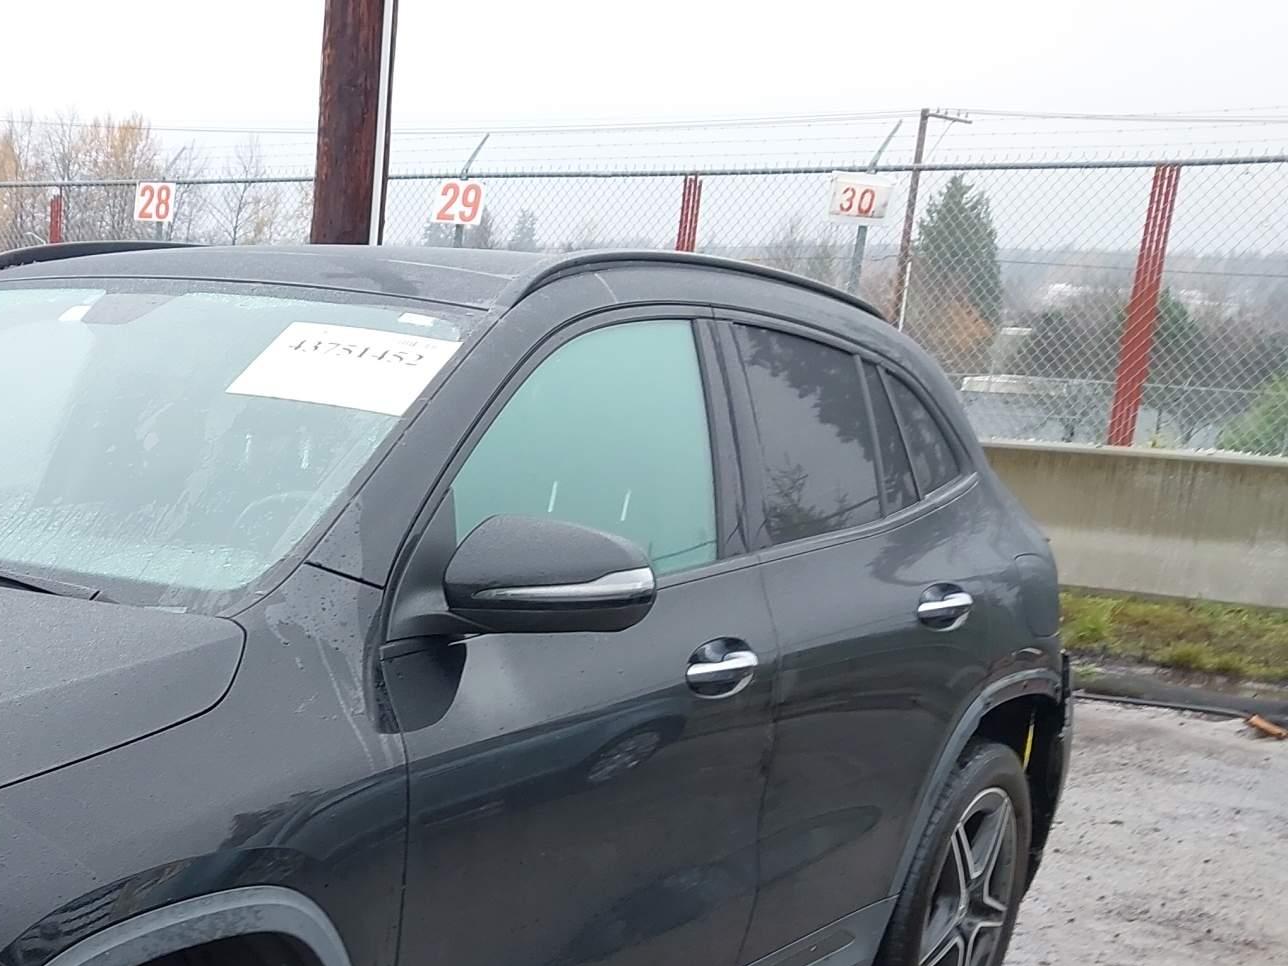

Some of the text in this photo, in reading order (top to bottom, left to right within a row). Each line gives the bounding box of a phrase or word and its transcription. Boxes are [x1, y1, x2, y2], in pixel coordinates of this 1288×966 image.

[139, 184, 171, 219] 28
[436, 182, 482, 222] 29
[839, 186, 876, 214] 30
[287, 338, 425, 367] 43751452
